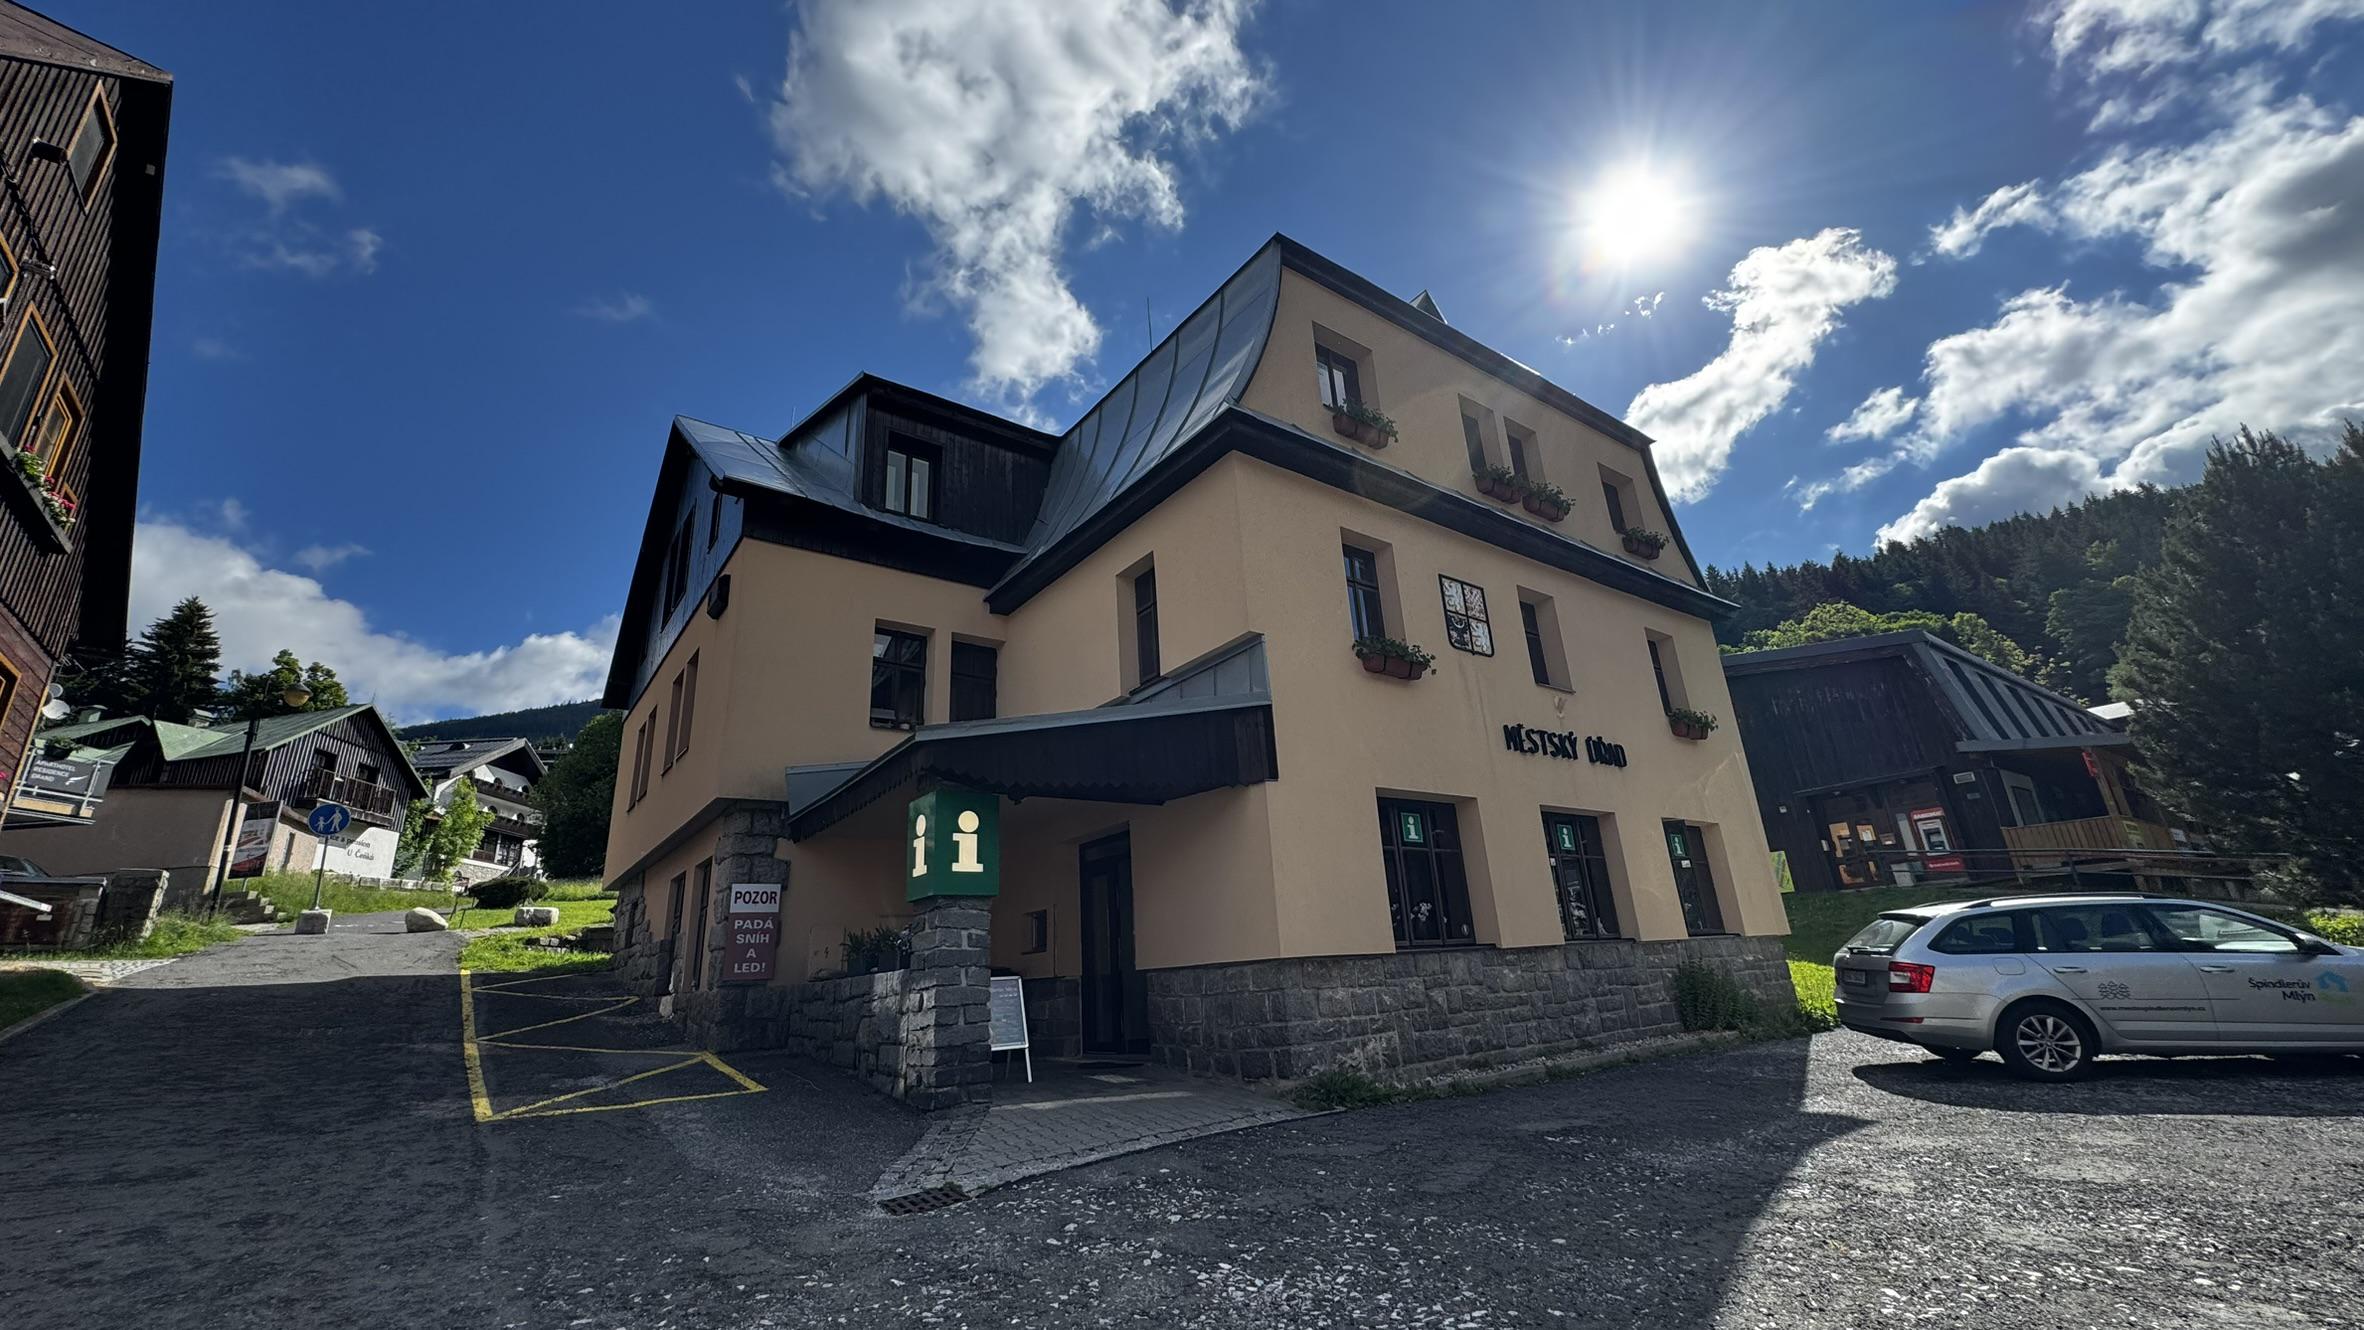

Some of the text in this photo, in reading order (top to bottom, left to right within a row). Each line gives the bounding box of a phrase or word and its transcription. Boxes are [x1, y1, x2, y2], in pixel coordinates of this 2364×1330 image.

[1503, 723, 1627, 767] MĚSTSKÝ ÚŘAD
[347, 849, 354, 857] U
[734, 890, 778, 905] POZOR
[734, 916, 774, 930] PADÁ
[736, 931, 770, 944] SNÍH
[746, 948, 757, 959] A
[734, 962, 766, 973] LED!
[2282, 989, 2316, 1003] Mlýn
